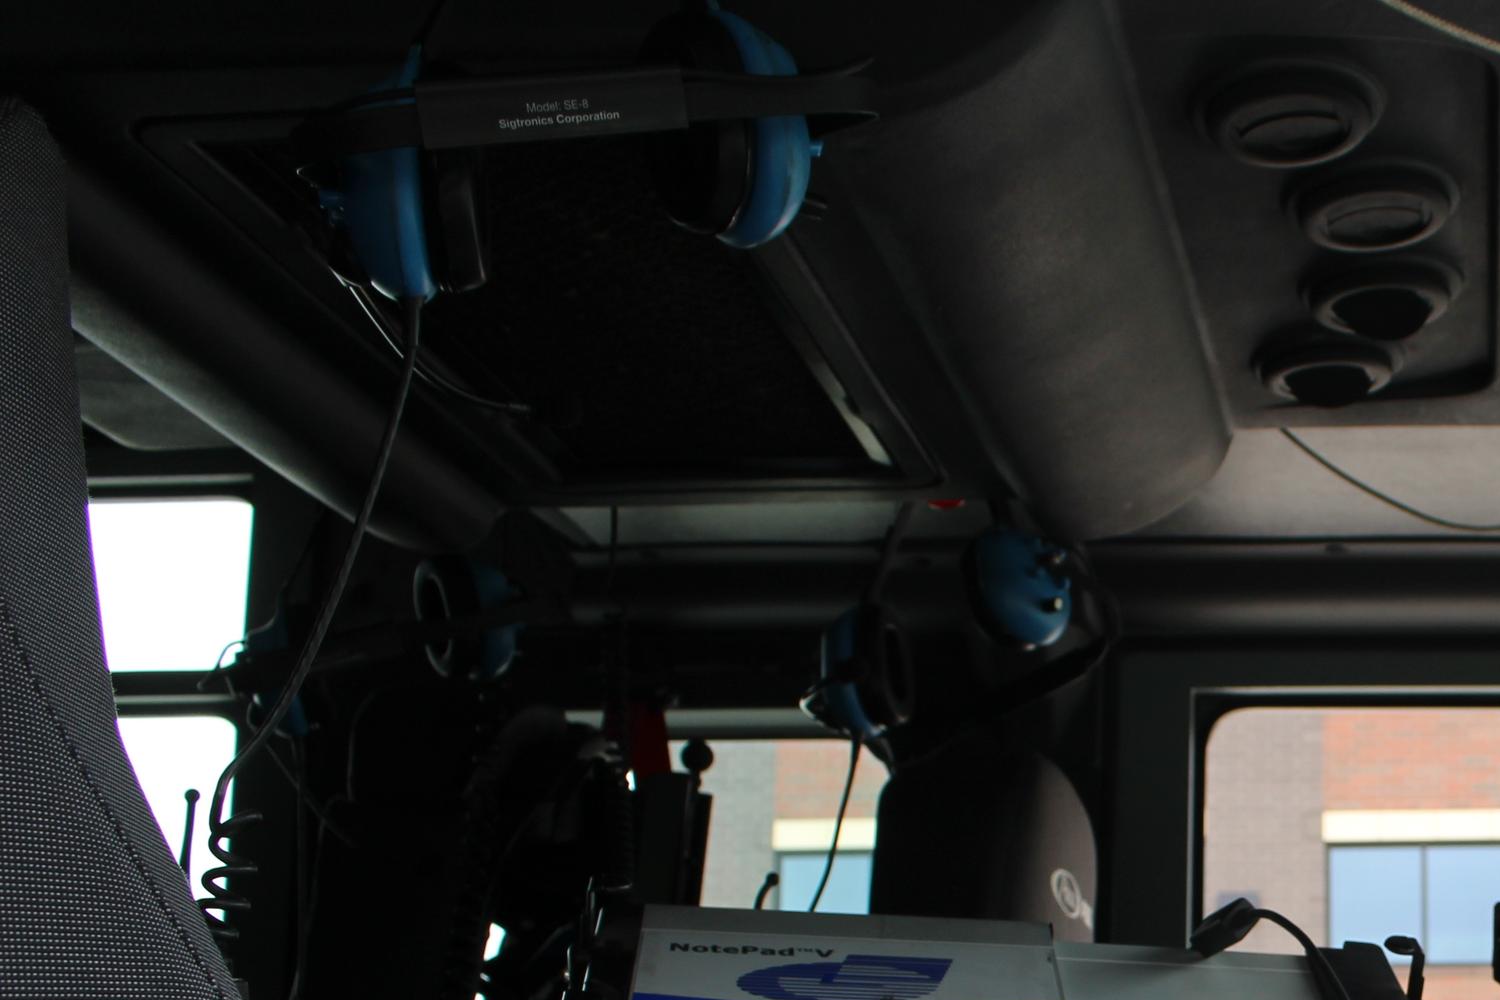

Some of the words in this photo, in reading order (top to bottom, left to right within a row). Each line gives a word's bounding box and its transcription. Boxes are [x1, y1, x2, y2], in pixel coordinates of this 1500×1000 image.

[526, 101, 562, 113] Model:
[563, 98, 589, 111] SE-8
[498, 115, 554, 130] Sigtronics
[556, 110, 620, 124] Corporation
